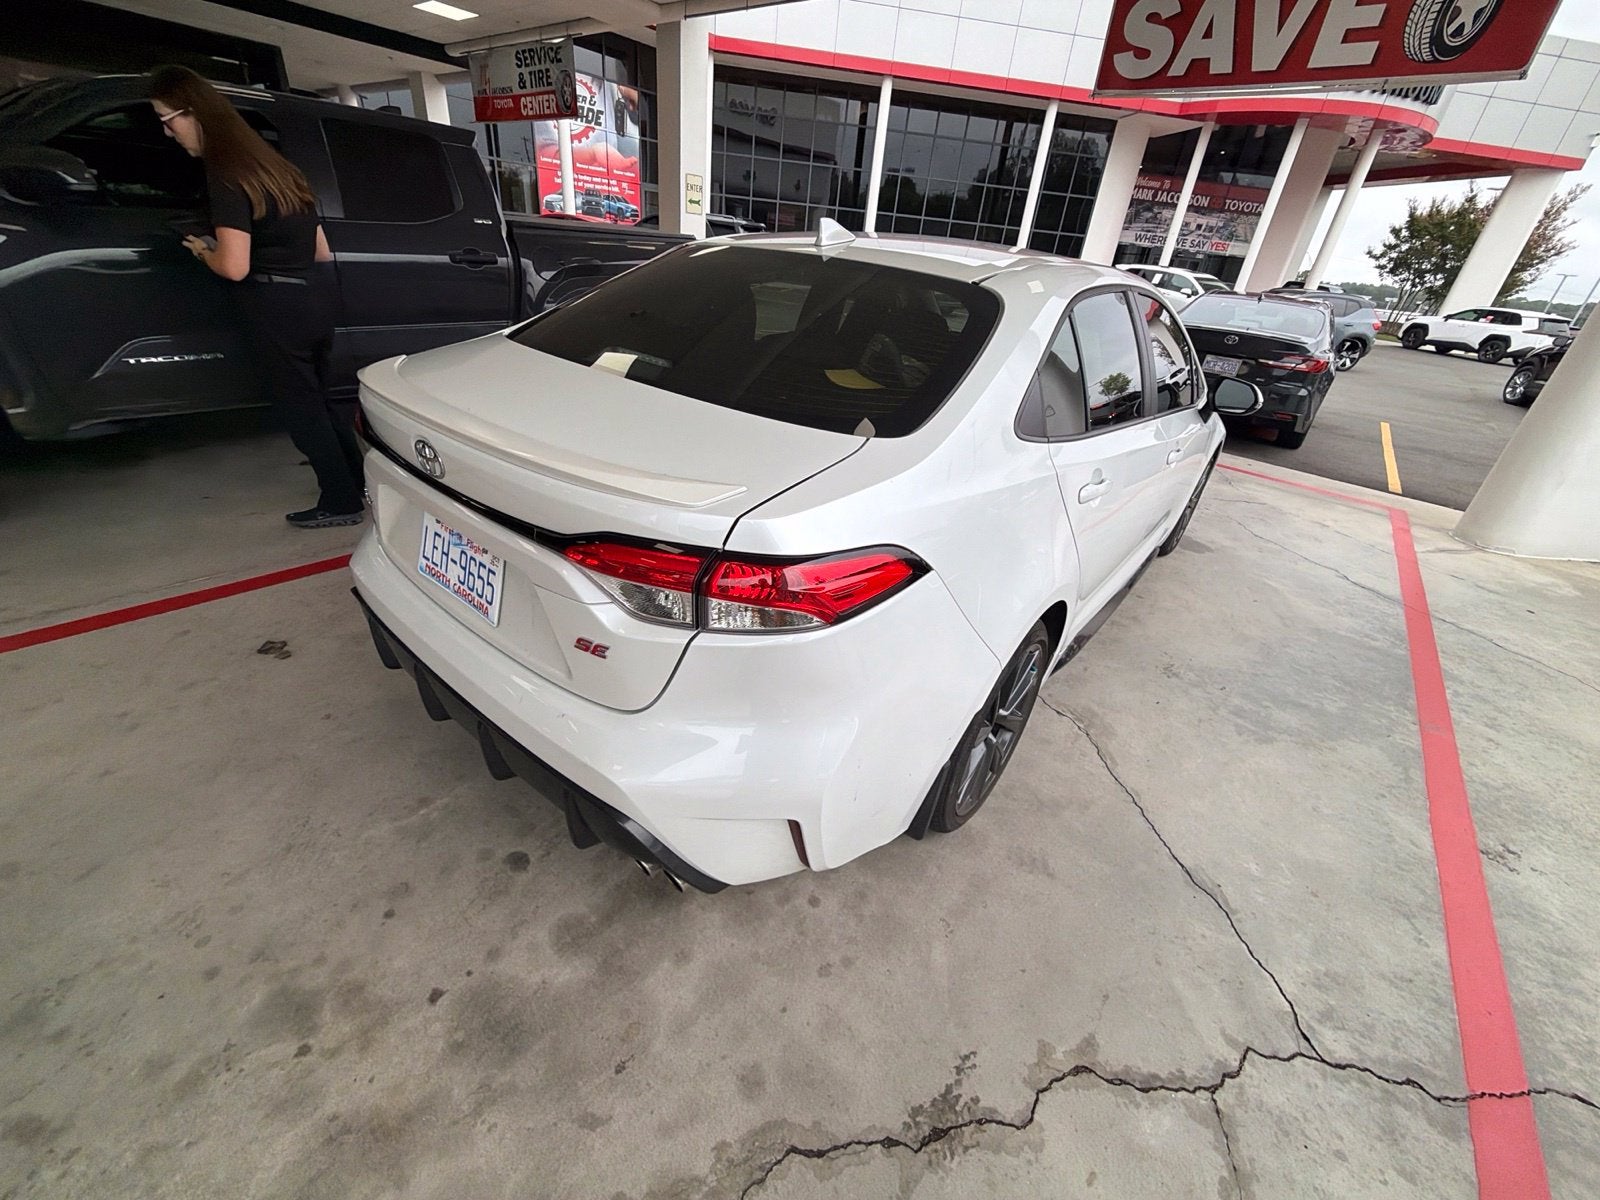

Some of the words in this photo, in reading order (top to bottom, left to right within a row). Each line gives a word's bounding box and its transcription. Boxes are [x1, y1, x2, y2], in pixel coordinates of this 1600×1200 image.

[1113, 0, 1387, 79] SAVE
[515, 45, 562, 69] SERVICE
[518, 72, 527, 90] &
[528, 68, 553, 89] TIRE
[493, 98, 514, 109] TOYOTA
[520, 94, 558, 116] CENTER
[588, 95, 597, 106] &
[686, 183, 703, 193] ENTER
[1135, 176, 1161, 188] Welcome
[1162, 179, 1172, 189] To
[1155, 190, 1210, 208] JACOSON
[1224, 199, 1265, 213] TOYOTA
[1189, 240, 1209, 250] SAY
[1209, 241, 1230, 252] YES!
[440, 523, 454, 536] First
[466, 538, 484, 556] Flight
[422, 525, 496, 606] LEH-9655
[424, 562, 451, 588] NORTH
[453, 583, 489, 618] CAROLINA
[574, 636, 610, 660] SE
